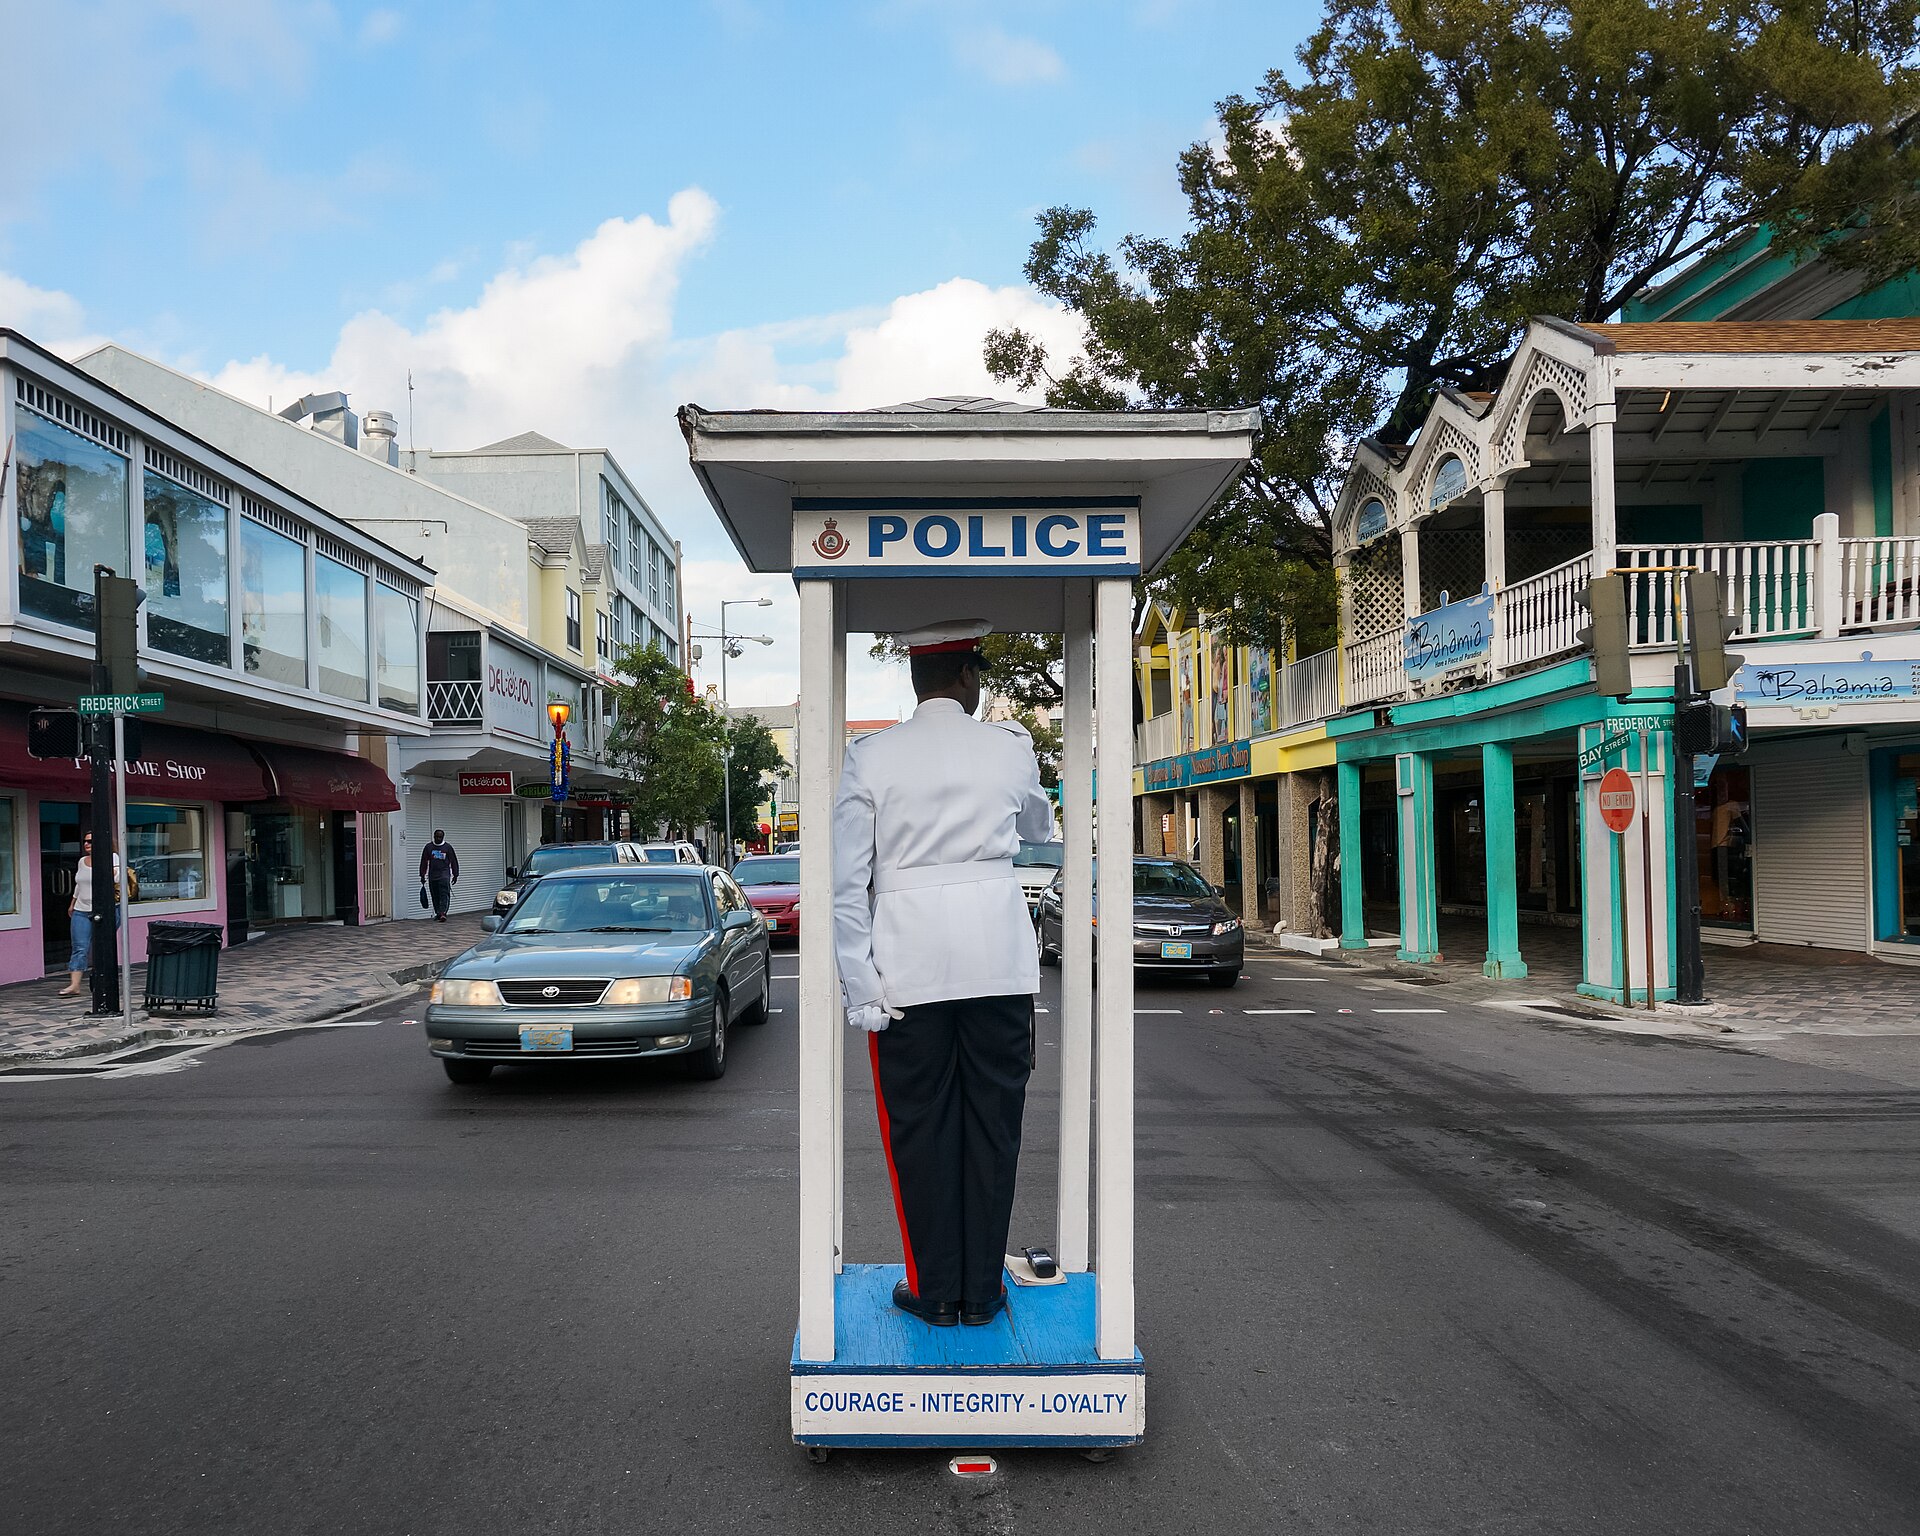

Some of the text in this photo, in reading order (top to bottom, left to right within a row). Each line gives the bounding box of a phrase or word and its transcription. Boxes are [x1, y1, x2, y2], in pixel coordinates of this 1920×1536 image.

[1434, 482, 1467, 506] T-Shirts
[868, 514, 1127, 558] POLICE
[1360, 522, 1388, 540] Apparel
[1418, 621, 1482, 670] Bahamia
[1773, 671, 1893, 701] Bahamia
[80, 696, 162, 711] FREDERICK STREET
[1607, 716, 1661, 731] FREDERICK
[1231, 745, 1249, 772] Shop
[1580, 734, 1630, 768] BAY STREET
[462, 777, 508, 787] DEL SOL
[1602, 793, 1632, 807] NO ENTRY
[805, 1391, 904, 1413] COURAGE
[921, 1392, 1025, 1413] INTEGRITY
[1041, 1393, 1128, 1414] LOYALTY
